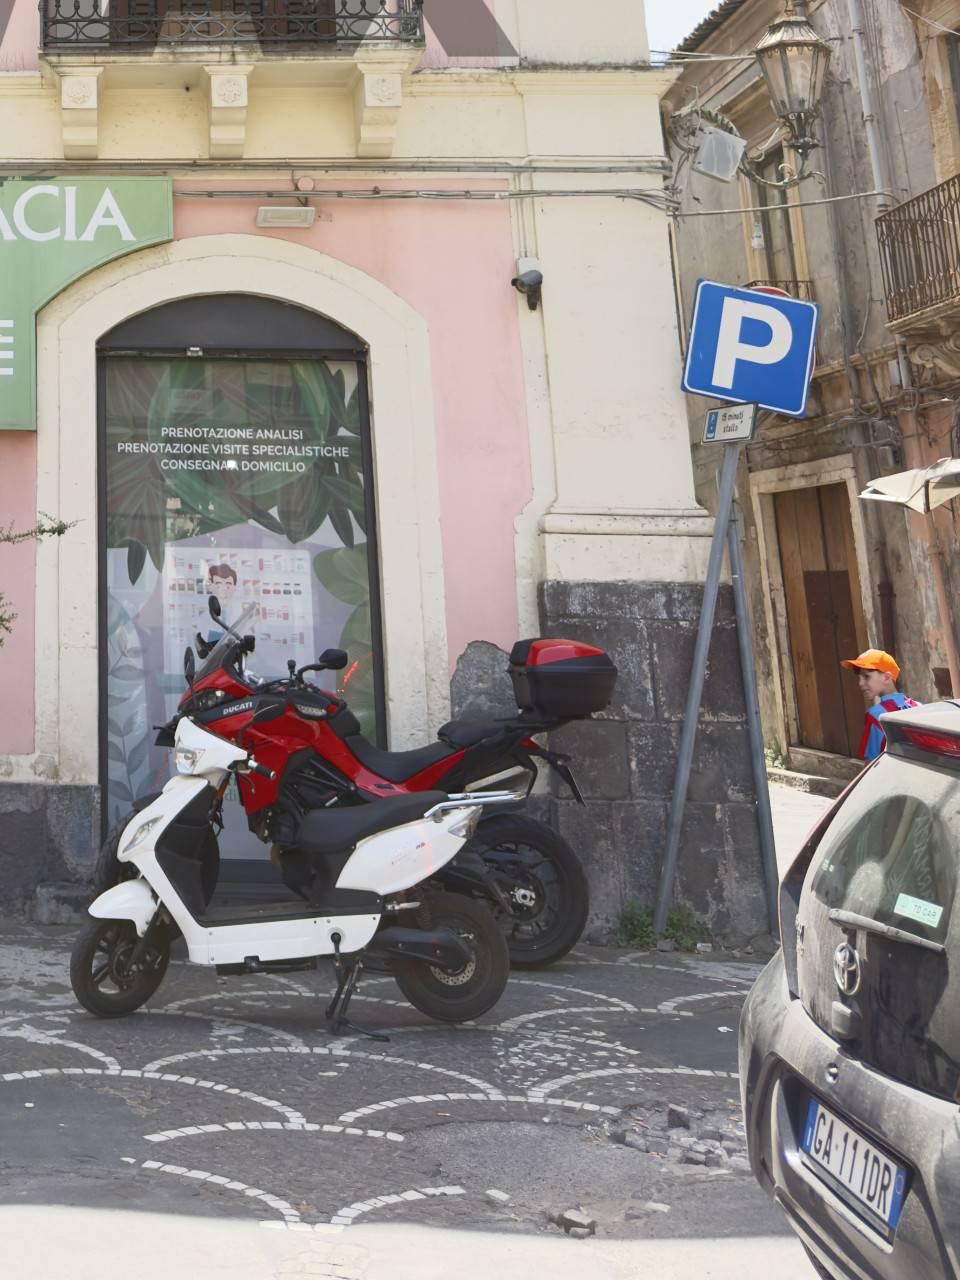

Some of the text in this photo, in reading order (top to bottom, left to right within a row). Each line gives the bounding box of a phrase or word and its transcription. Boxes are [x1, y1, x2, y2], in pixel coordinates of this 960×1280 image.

[711, 296, 792, 389] P
[161, 427, 303, 440] PRENOTAZIONE ANALISI
[117, 443, 350, 457] PRENOTAZIONE VISITE SPECIALISTICHE
[241, 461, 306, 472] DOMICILIO
[223, 701, 253, 715] DUCATI
[813, 1112, 834, 1165] GA
[839, 1131, 892, 1215] 111DR
